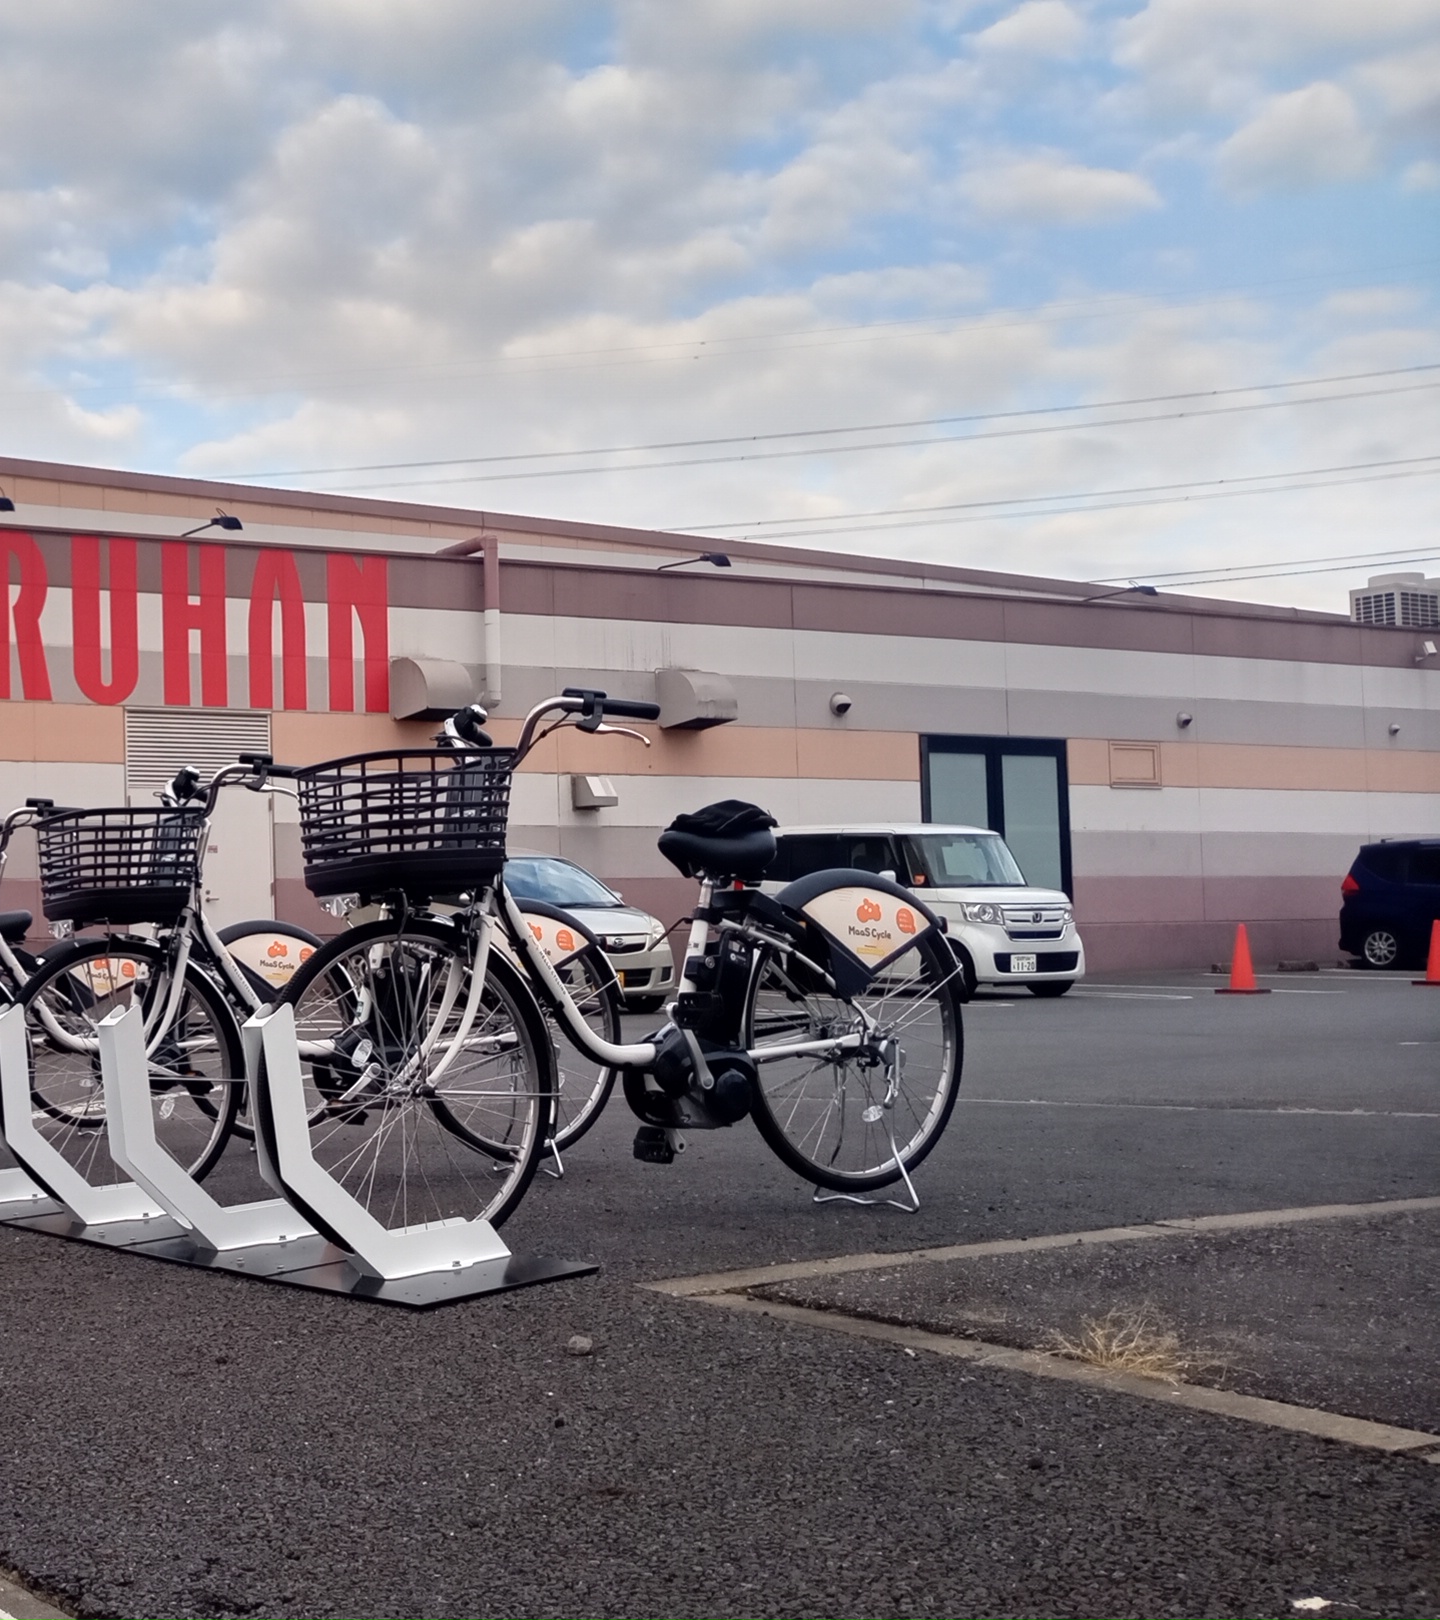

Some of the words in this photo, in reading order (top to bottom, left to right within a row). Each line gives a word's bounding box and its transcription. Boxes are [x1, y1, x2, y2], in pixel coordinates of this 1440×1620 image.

[848, 925, 871, 937] MaaS
[871, 928, 892, 940] Cycle
[260, 960, 278, 968] MaaS
[278, 961, 295, 970] Cycle
